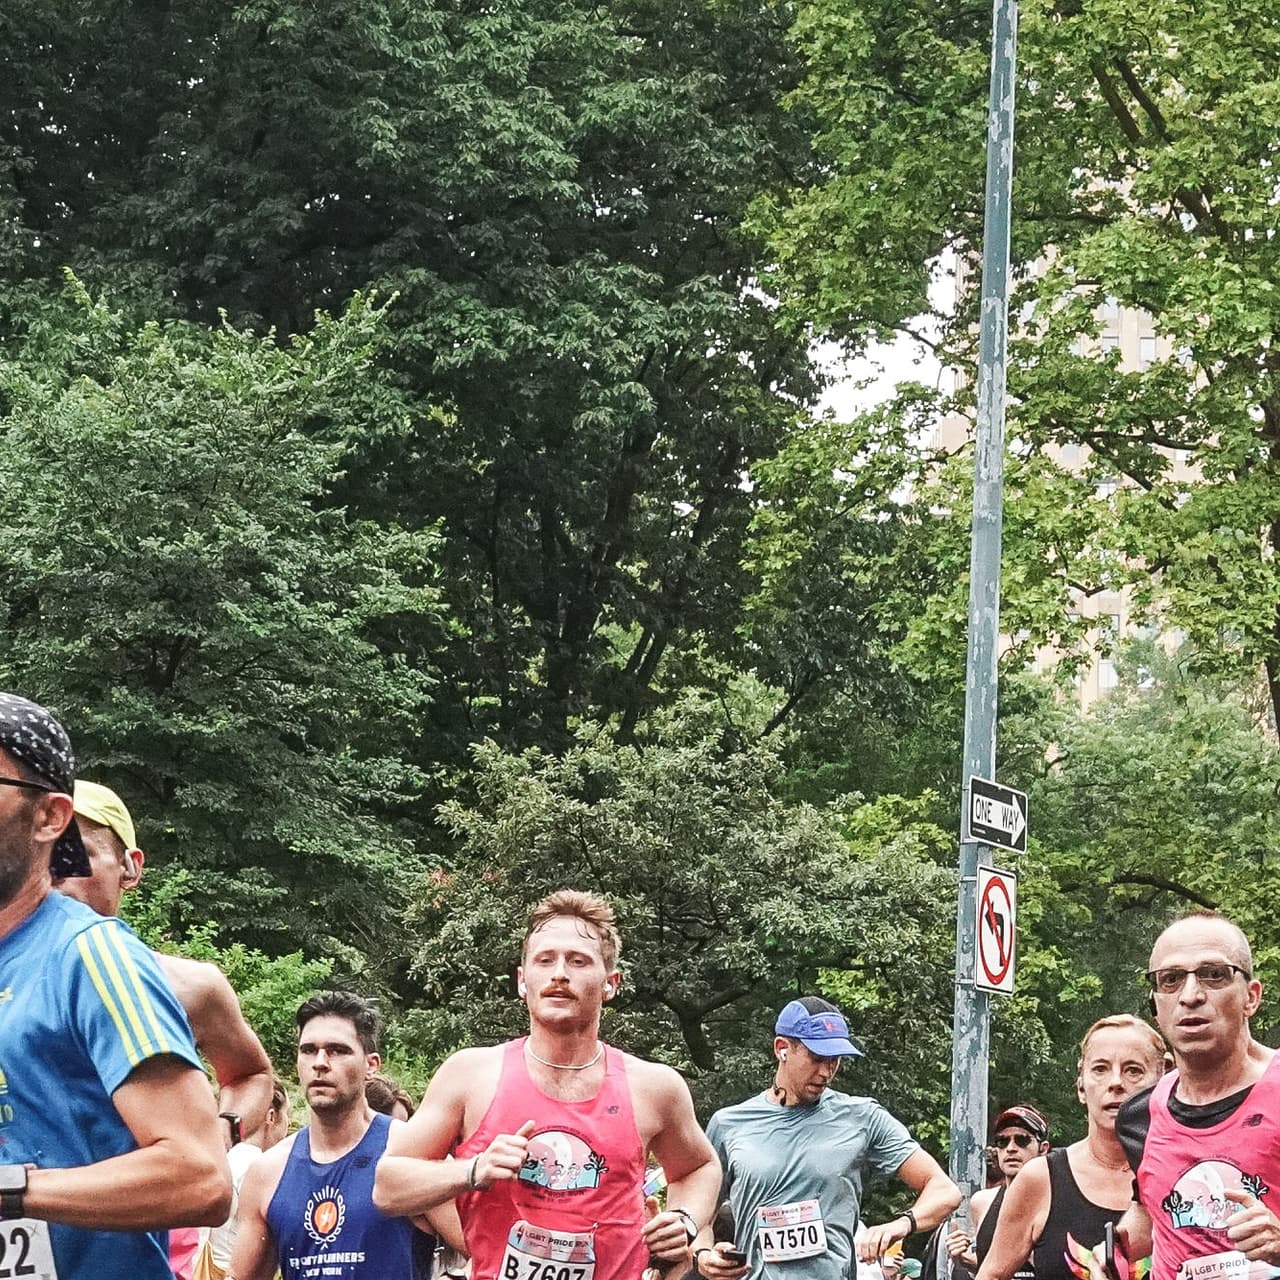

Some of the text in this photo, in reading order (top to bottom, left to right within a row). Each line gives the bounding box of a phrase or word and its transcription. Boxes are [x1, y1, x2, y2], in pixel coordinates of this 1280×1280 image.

[976, 798, 1019, 832] ONE WAY
[525, 1231, 546, 1242] LGBT
[548, 1238, 573, 1248] PRIDE
[764, 1225, 818, 1250] A 7570
[504, 1254, 519, 1280] B
[1195, 1264, 1217, 1275] LGBT
